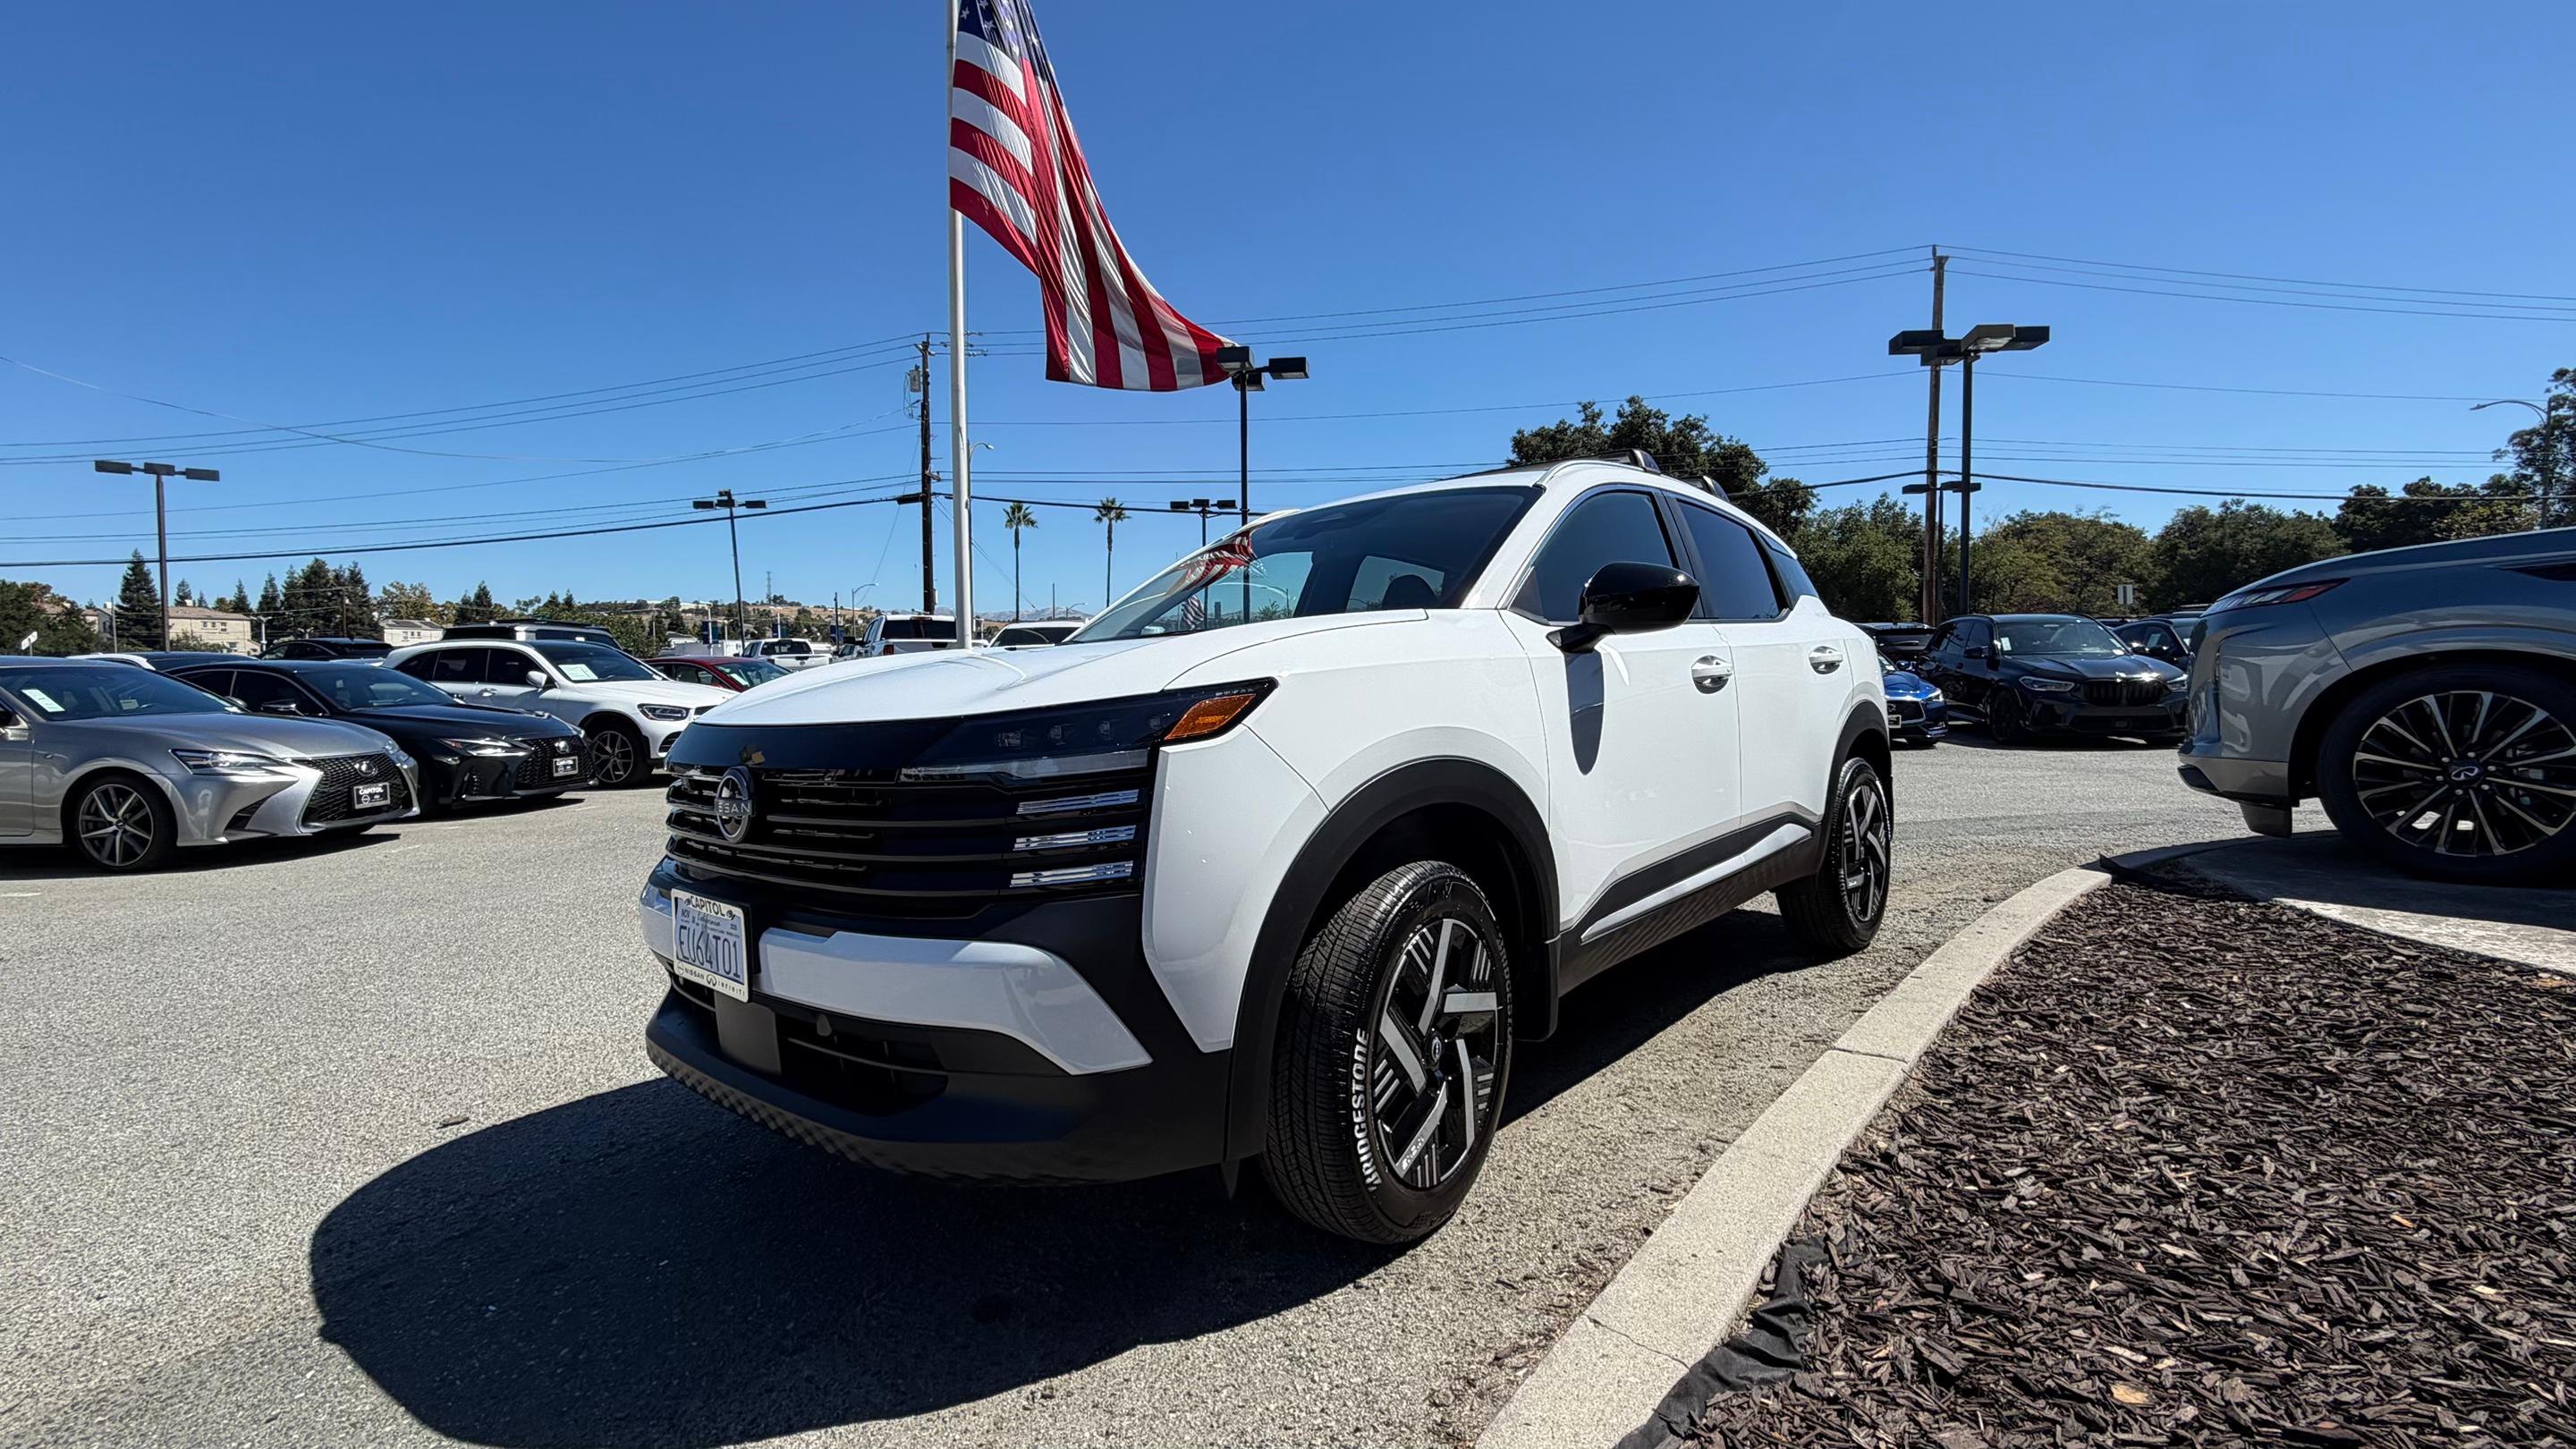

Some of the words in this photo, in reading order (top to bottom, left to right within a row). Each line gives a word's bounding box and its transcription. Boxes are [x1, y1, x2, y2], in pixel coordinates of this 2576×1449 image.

[691, 895, 725, 917] CAPITOL
[679, 925, 741, 979] EU64T01
[684, 967, 705, 980] NISSAN
[718, 980, 745, 996] INFINITI
[1352, 1028, 1382, 1193] BRIDGESTONE
